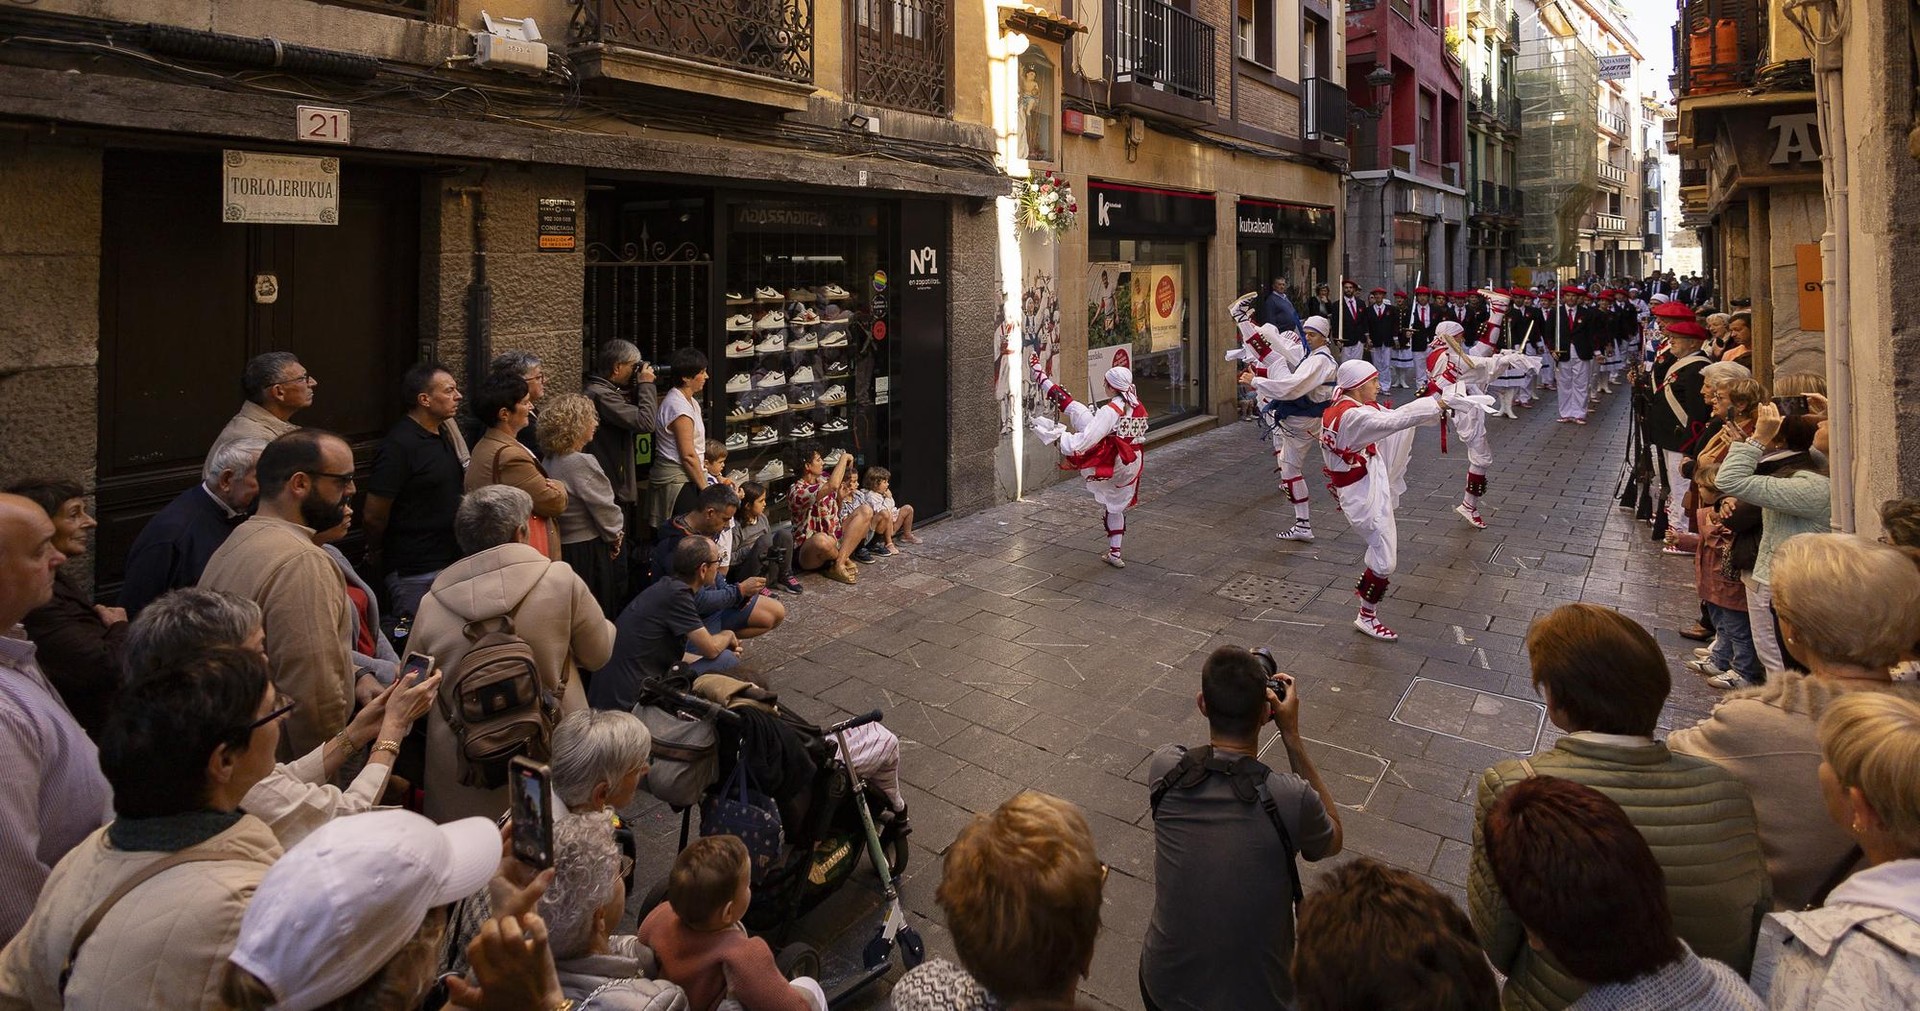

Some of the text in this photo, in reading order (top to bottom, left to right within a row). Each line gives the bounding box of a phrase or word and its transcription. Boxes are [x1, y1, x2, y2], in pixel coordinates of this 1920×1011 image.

[309, 113, 338, 138] 21
[231, 177, 333, 199] TORLOJERUKUA
[540, 199, 576, 207] segurma
[1239, 216, 1274, 234] kutxabank
